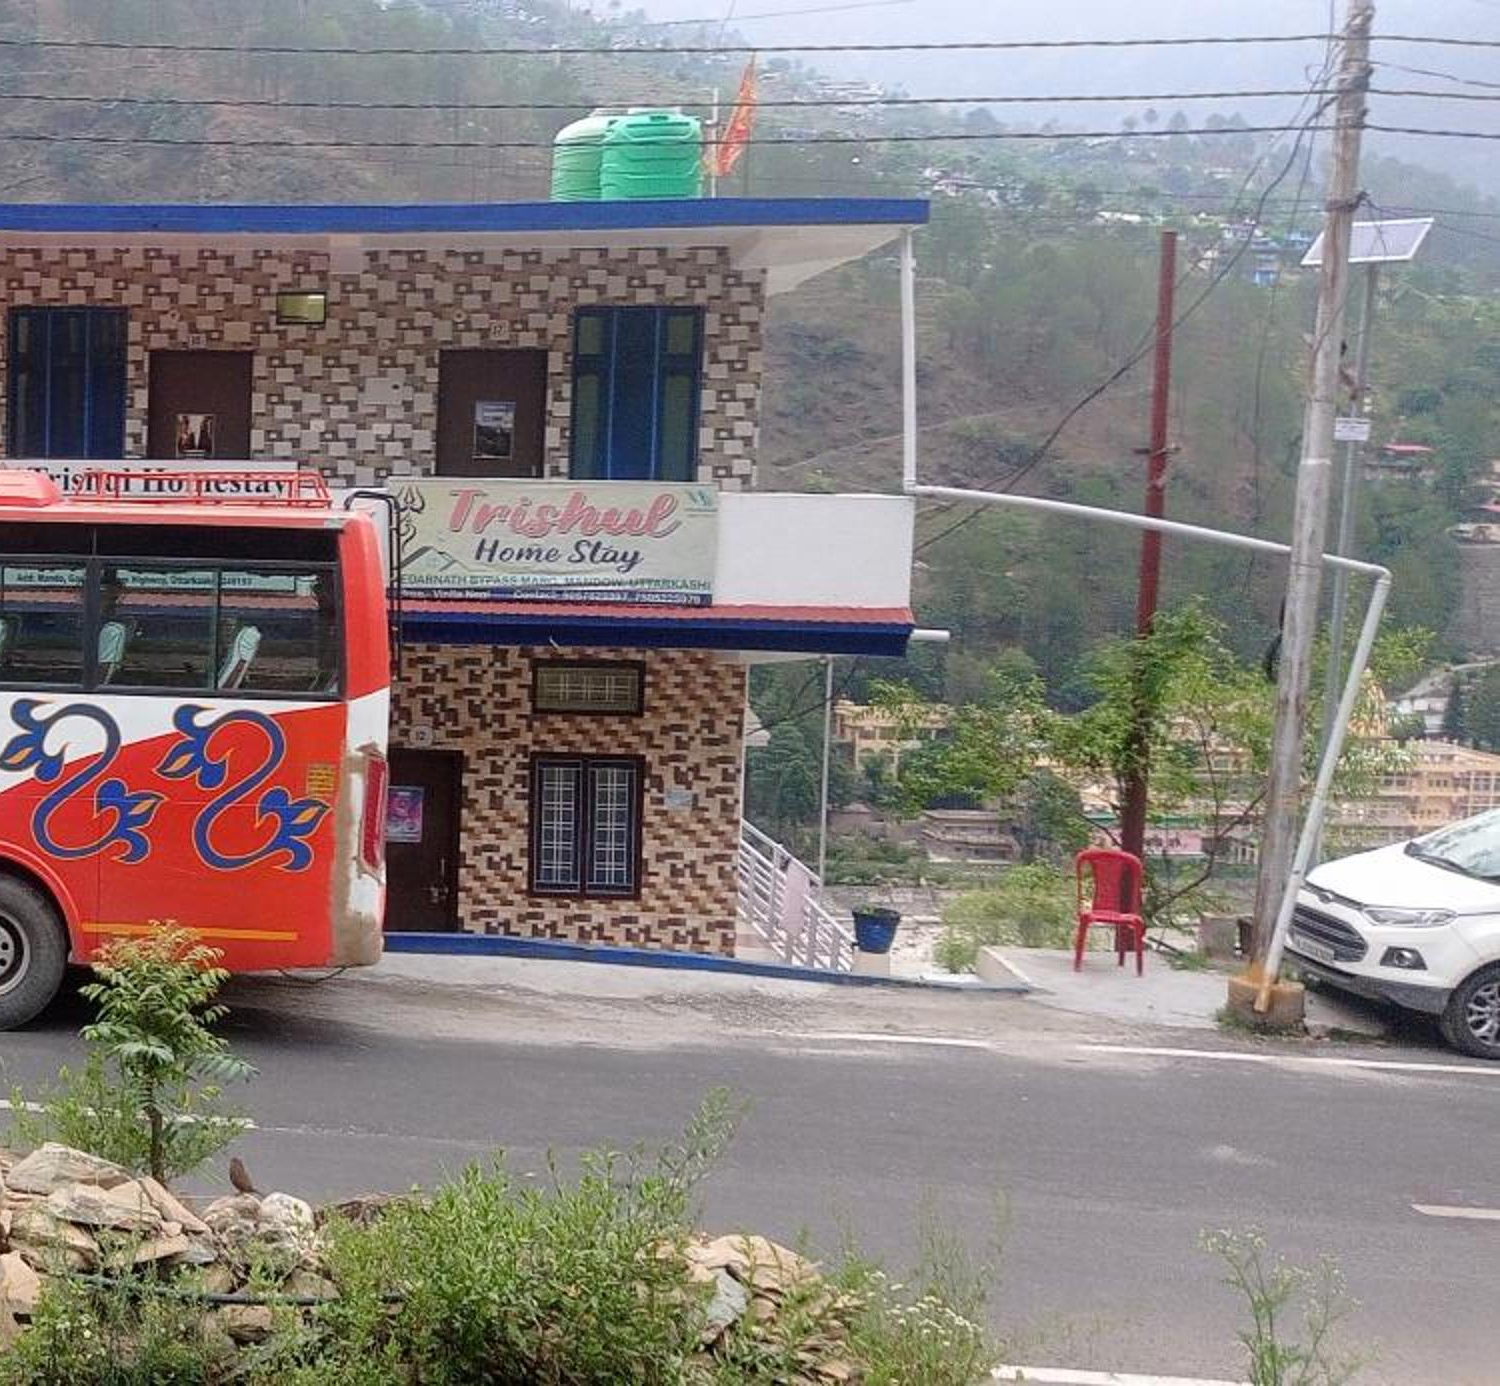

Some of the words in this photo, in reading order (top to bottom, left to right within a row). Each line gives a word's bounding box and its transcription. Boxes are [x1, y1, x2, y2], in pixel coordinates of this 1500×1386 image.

[447, 488, 682, 539] Trishul
[475, 538, 561, 565] Home
[568, 538, 645, 574] Stay
[400, 574, 467, 585] EDARNATH
